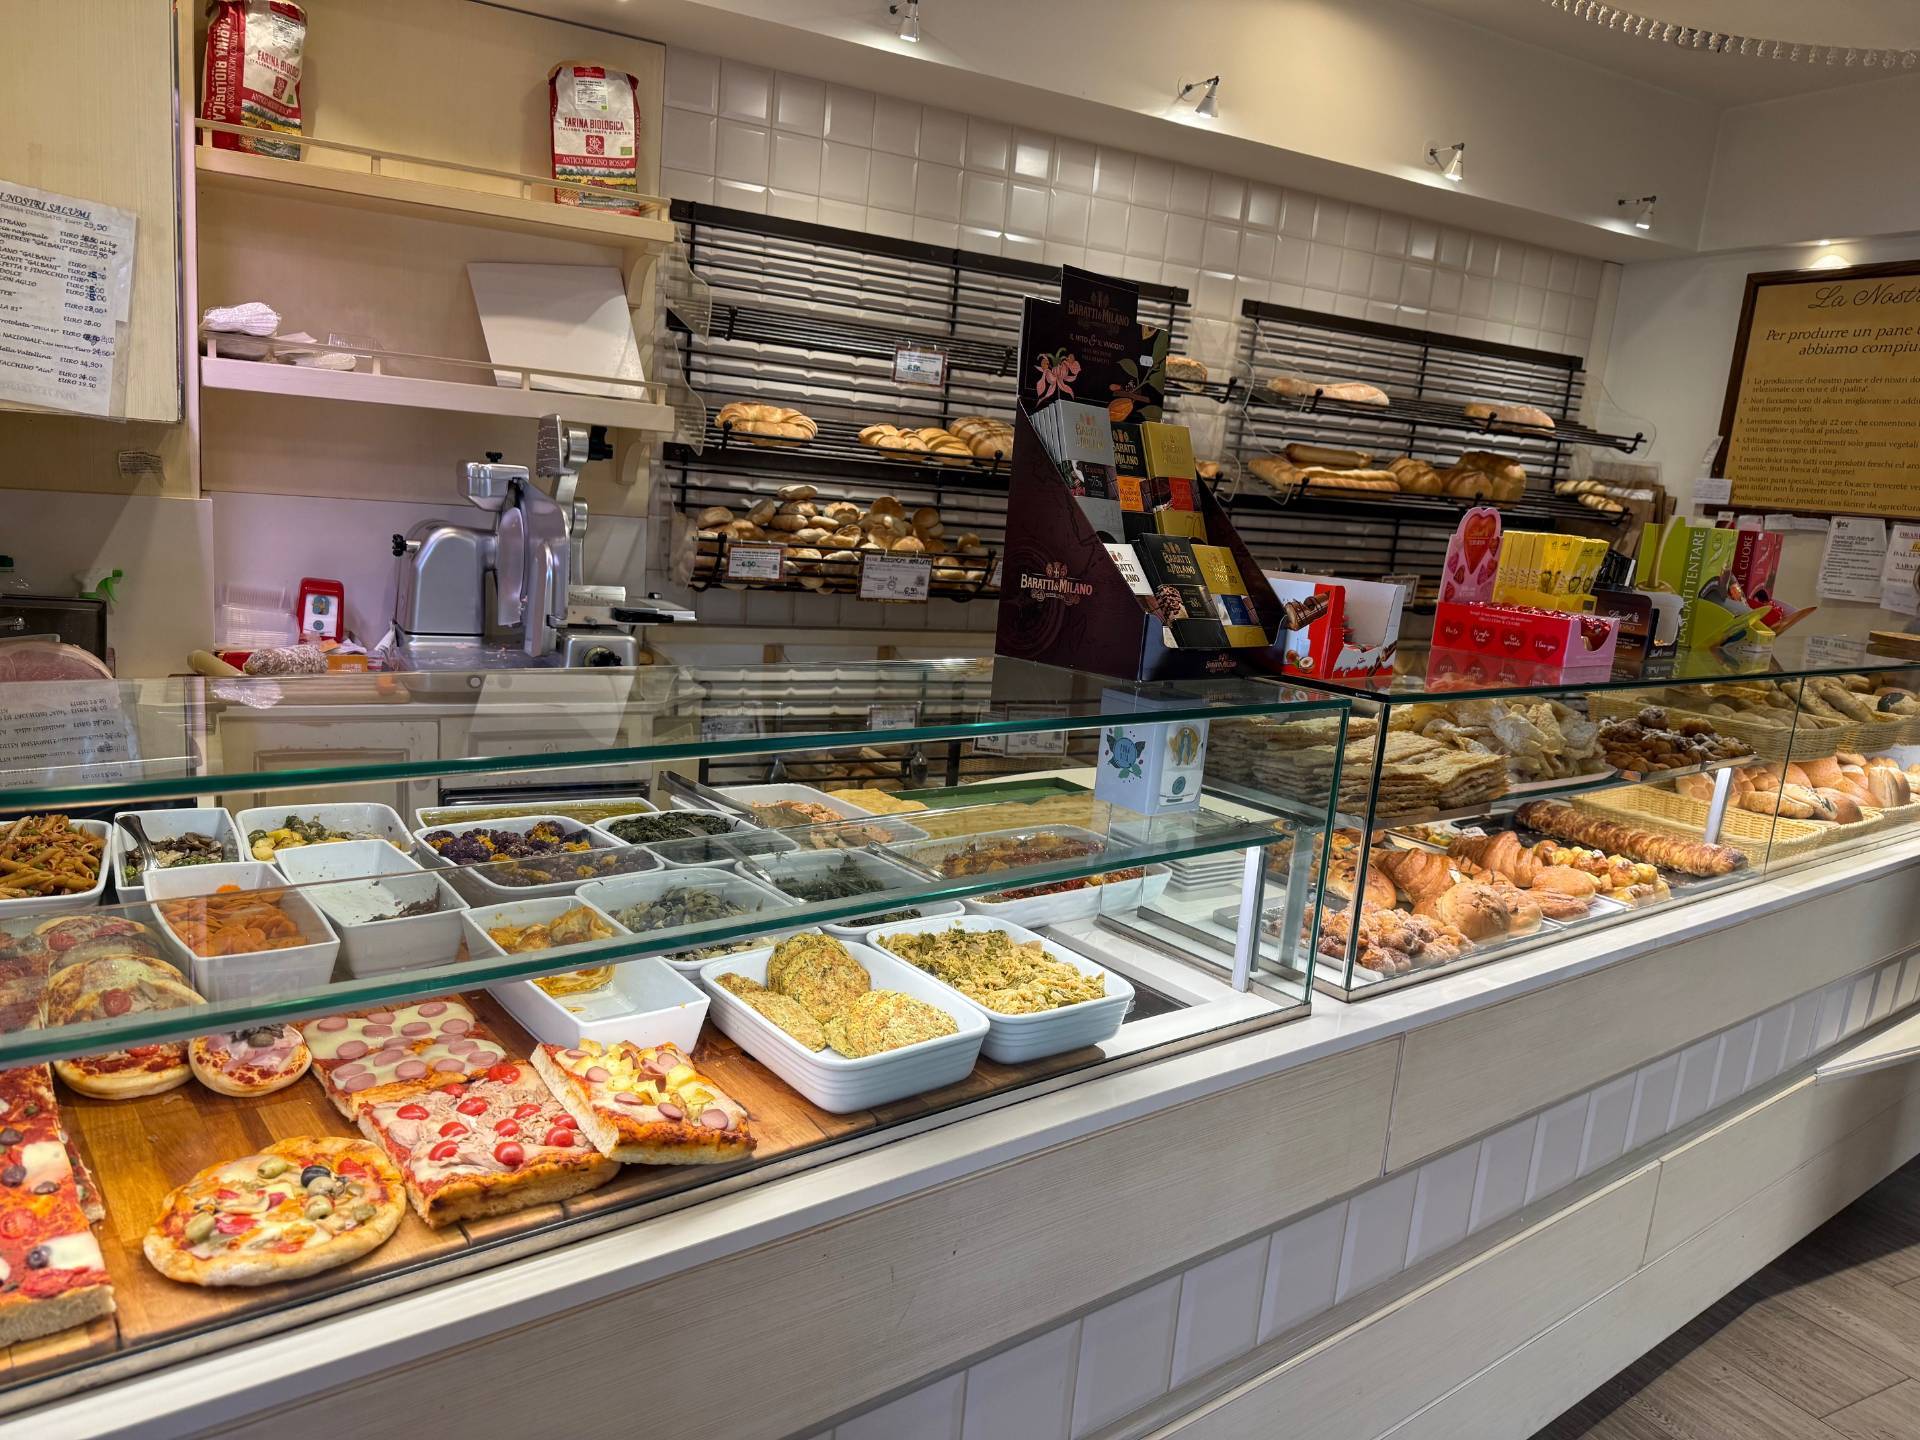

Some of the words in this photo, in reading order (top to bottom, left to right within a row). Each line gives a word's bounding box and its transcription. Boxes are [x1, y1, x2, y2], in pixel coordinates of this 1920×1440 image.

[214, 17, 231, 57] FARINA
[212, 61, 228, 120] BIOLOGICA
[564, 116, 589, 129] FARINA
[590, 119, 625, 132] BIOLOGICA
[6, 194, 46, 210] NOSTRI
[60, 231, 79, 239] EURO
[1808, 285, 1849, 309] La
[1766, 329, 1787, 341] Per
[1787, 327, 1849, 344] produrre
[1853, 328, 1872, 337] un
[1875, 326, 1913, 341] pane
[1798, 342, 1859, 356] abbiamo
[1861, 340, 1920, 357] compiu
[58, 370, 78, 379] EURO
[57, 377, 77, 386] EURO
[1804, 376, 1818, 385] del
[1843, 377, 1864, 387] pane
[1854, 418, 1869, 427] che
[1803, 437, 1846, 447] condimenti
[1847, 439, 1864, 447] solo
[1888, 439, 1918, 450] vegetali
[1765, 446, 1809, 456] extravergine
[1802, 457, 1818, 466] fatti
[1834, 458, 1866, 468] prodotti
[1795, 486, 1828, 495] troverete
[1828, 487, 1849, 496] tutto
[1873, 481, 1909, 490] troverete
[1774, 495, 1796, 504] anche
[1796, 496, 1826, 506] prodotti
[1740, 535, 1754, 570] CUORE
[1684, 530, 1706, 590] TENTARE
[1608, 609, 1633, 622] Lindt
